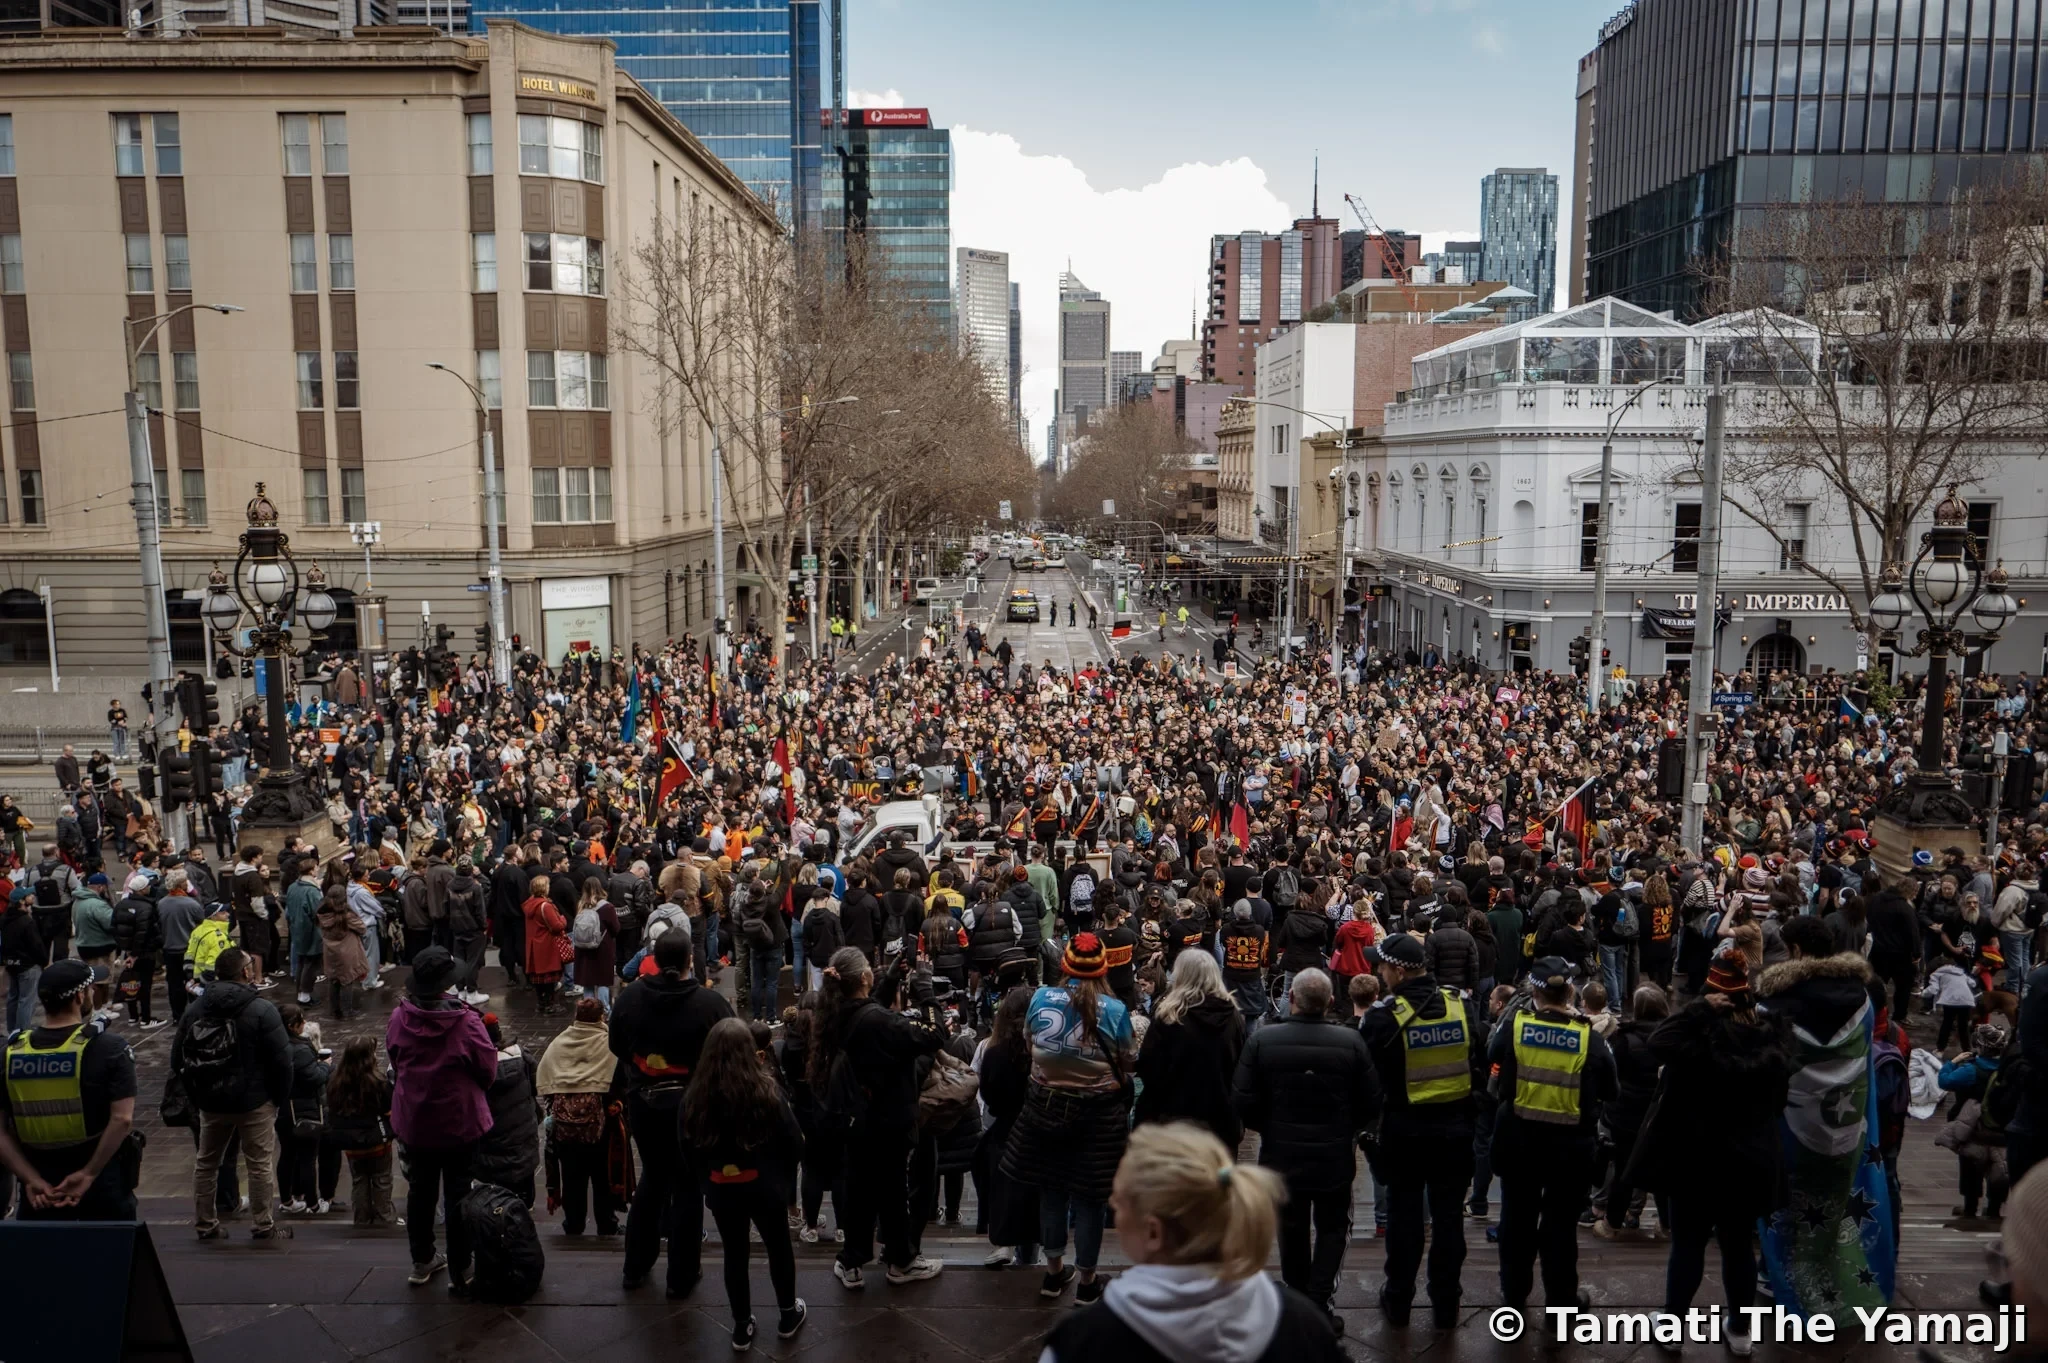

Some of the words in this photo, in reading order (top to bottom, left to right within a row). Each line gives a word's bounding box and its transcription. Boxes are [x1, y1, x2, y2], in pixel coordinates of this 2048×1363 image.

[522, 77, 554, 92] HOTEL
[558, 81, 596, 101] WINDSOR
[570, 583, 604, 593] WINDSOR
[1675, 593, 1722, 610] TE
[1720, 695, 1742, 703] Spring
[1035, 1007, 1098, 1058] 24
[1409, 1027, 1462, 1045] Police
[1523, 1026, 1578, 1048] Police
[11, 1058, 72, 1075] Police
